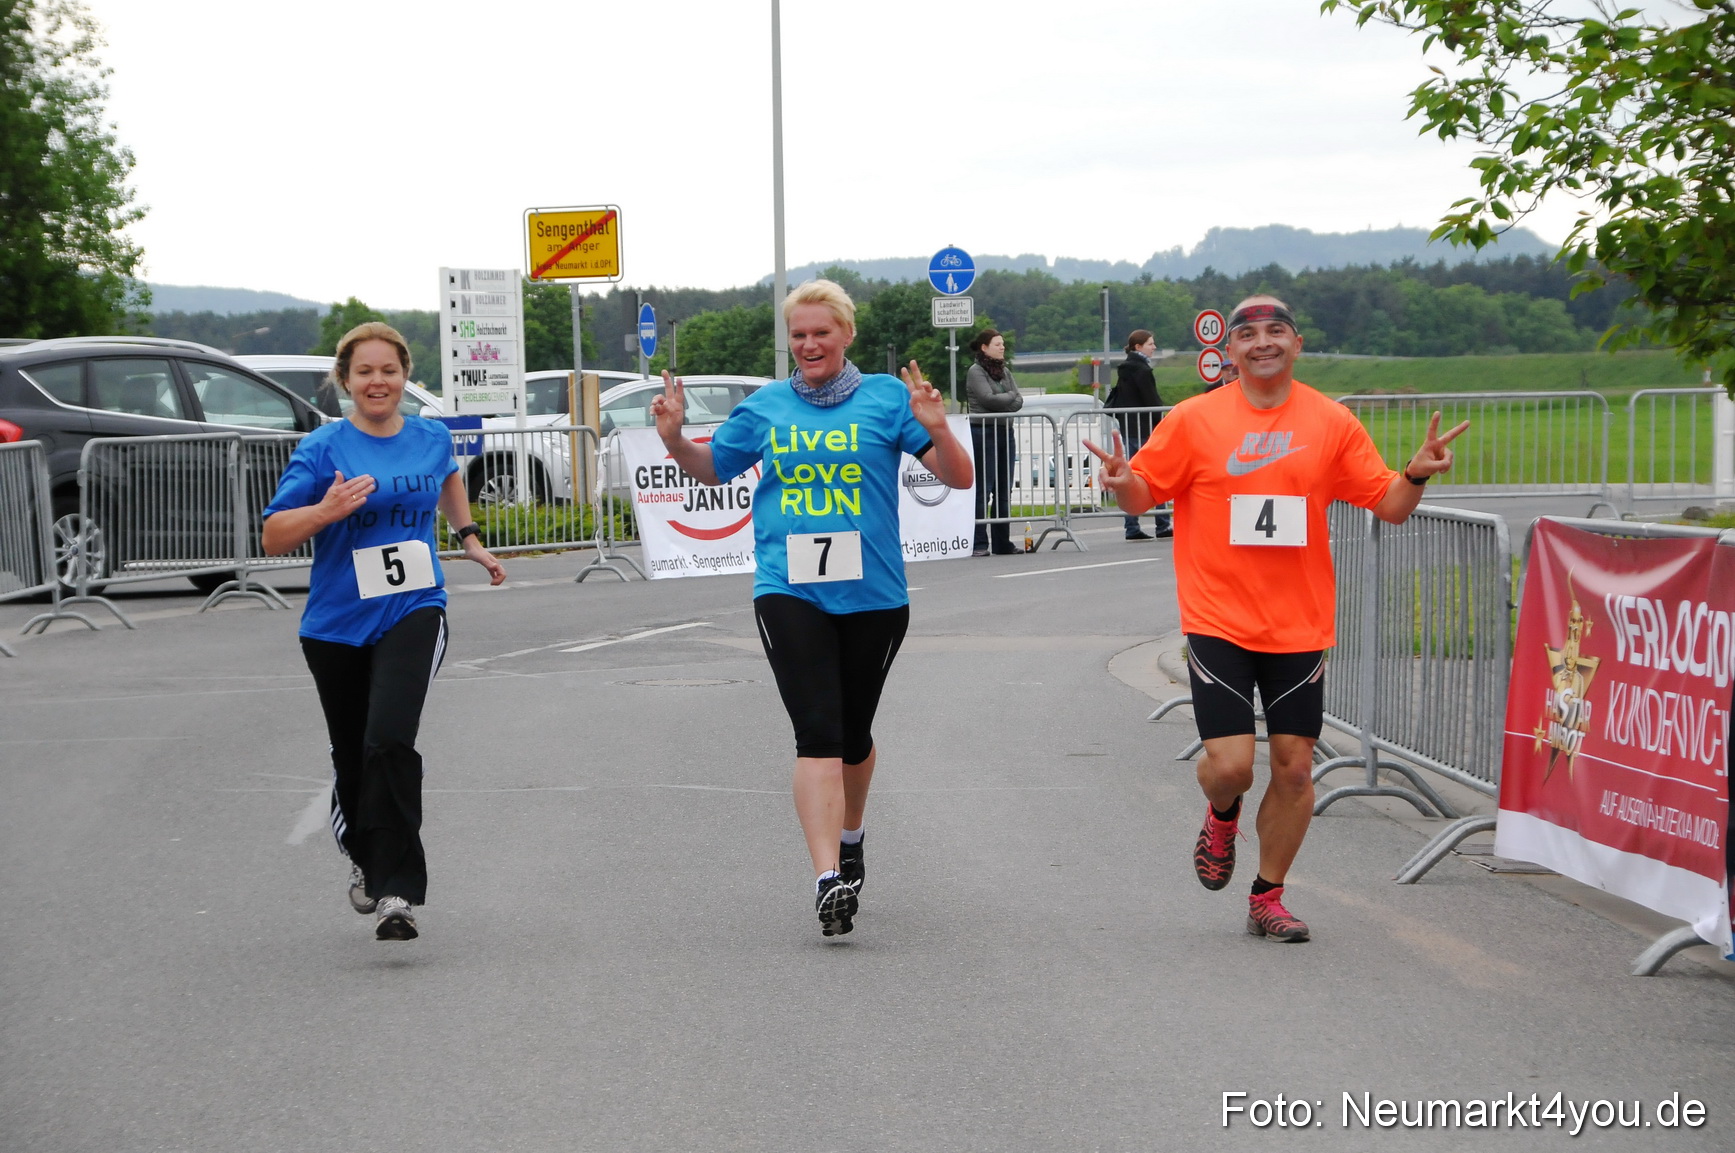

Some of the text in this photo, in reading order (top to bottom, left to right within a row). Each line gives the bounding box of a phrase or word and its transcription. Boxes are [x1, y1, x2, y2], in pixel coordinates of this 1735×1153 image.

[536, 218, 610, 241] Sengenthal
[547, 242, 600, 253] am Anger
[555, 259, 588, 270] Neumarkt
[937, 315, 958, 323] Verkehr
[1201, 319, 1219, 336] 60
[460, 368, 488, 387] THULE
[770, 423, 858, 454] Live!
[1239, 431, 1294, 456] RUN
[392, 474, 438, 493] run
[772, 459, 863, 484] Love
[637, 486, 751, 513] Autohaus JÄNIG
[780, 488, 862, 516] RUN
[1254, 498, 1277, 538] 4
[381, 546, 406, 587] 5
[650, 554, 688, 572] eumarkt
[692, 550, 746, 572] Sengenthal
[813, 537, 832, 576] 7
